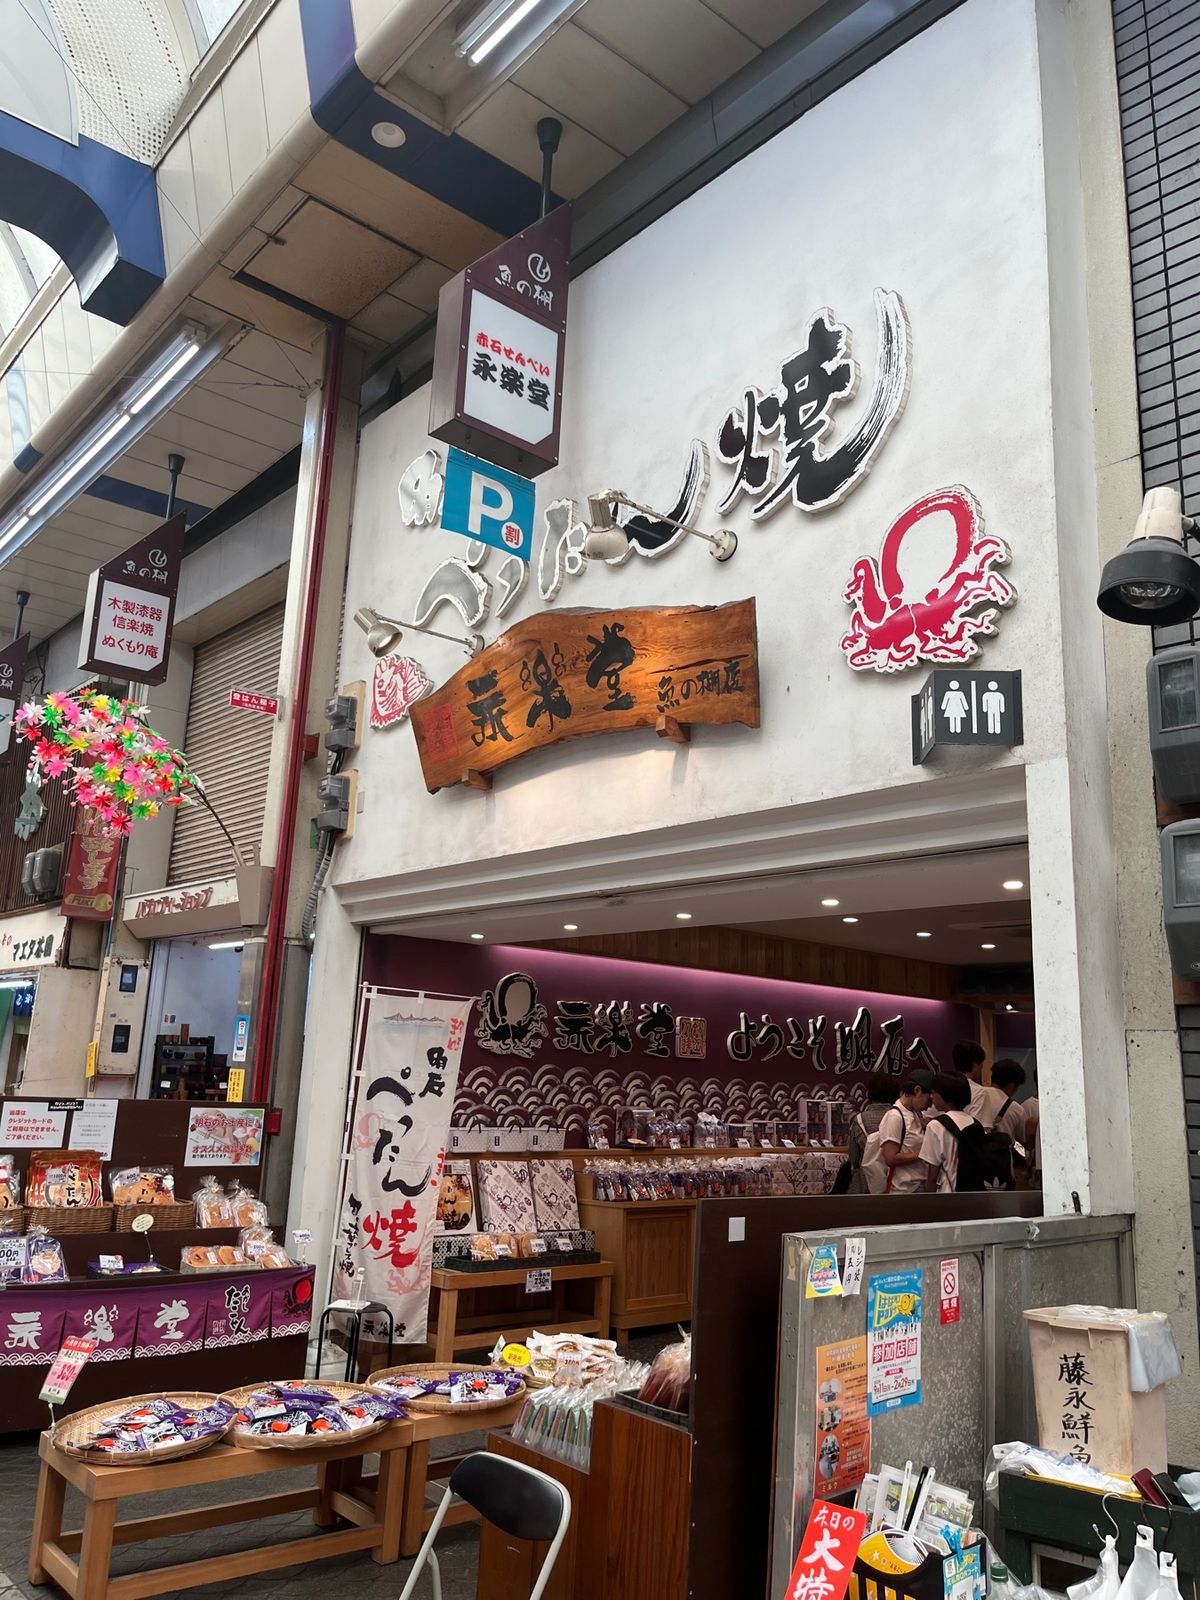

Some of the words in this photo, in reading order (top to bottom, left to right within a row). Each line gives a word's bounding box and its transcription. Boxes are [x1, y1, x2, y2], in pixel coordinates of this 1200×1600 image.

[495, 264, 553, 311] 魚の棚
[472, 352, 551, 411] 永楽堂
[468, 471, 514, 535] P
[504, 524, 522, 545] 割
[123, 559, 168, 584] 魚の棚
[108, 597, 163, 622] 木製漆器
[112, 615, 154, 637] 信楽焼
[102, 635, 158, 659] ぬくもり庵
[873, 1337, 918, 1365] 参加店舗
[813, 1505, 856, 1532] 本日の
